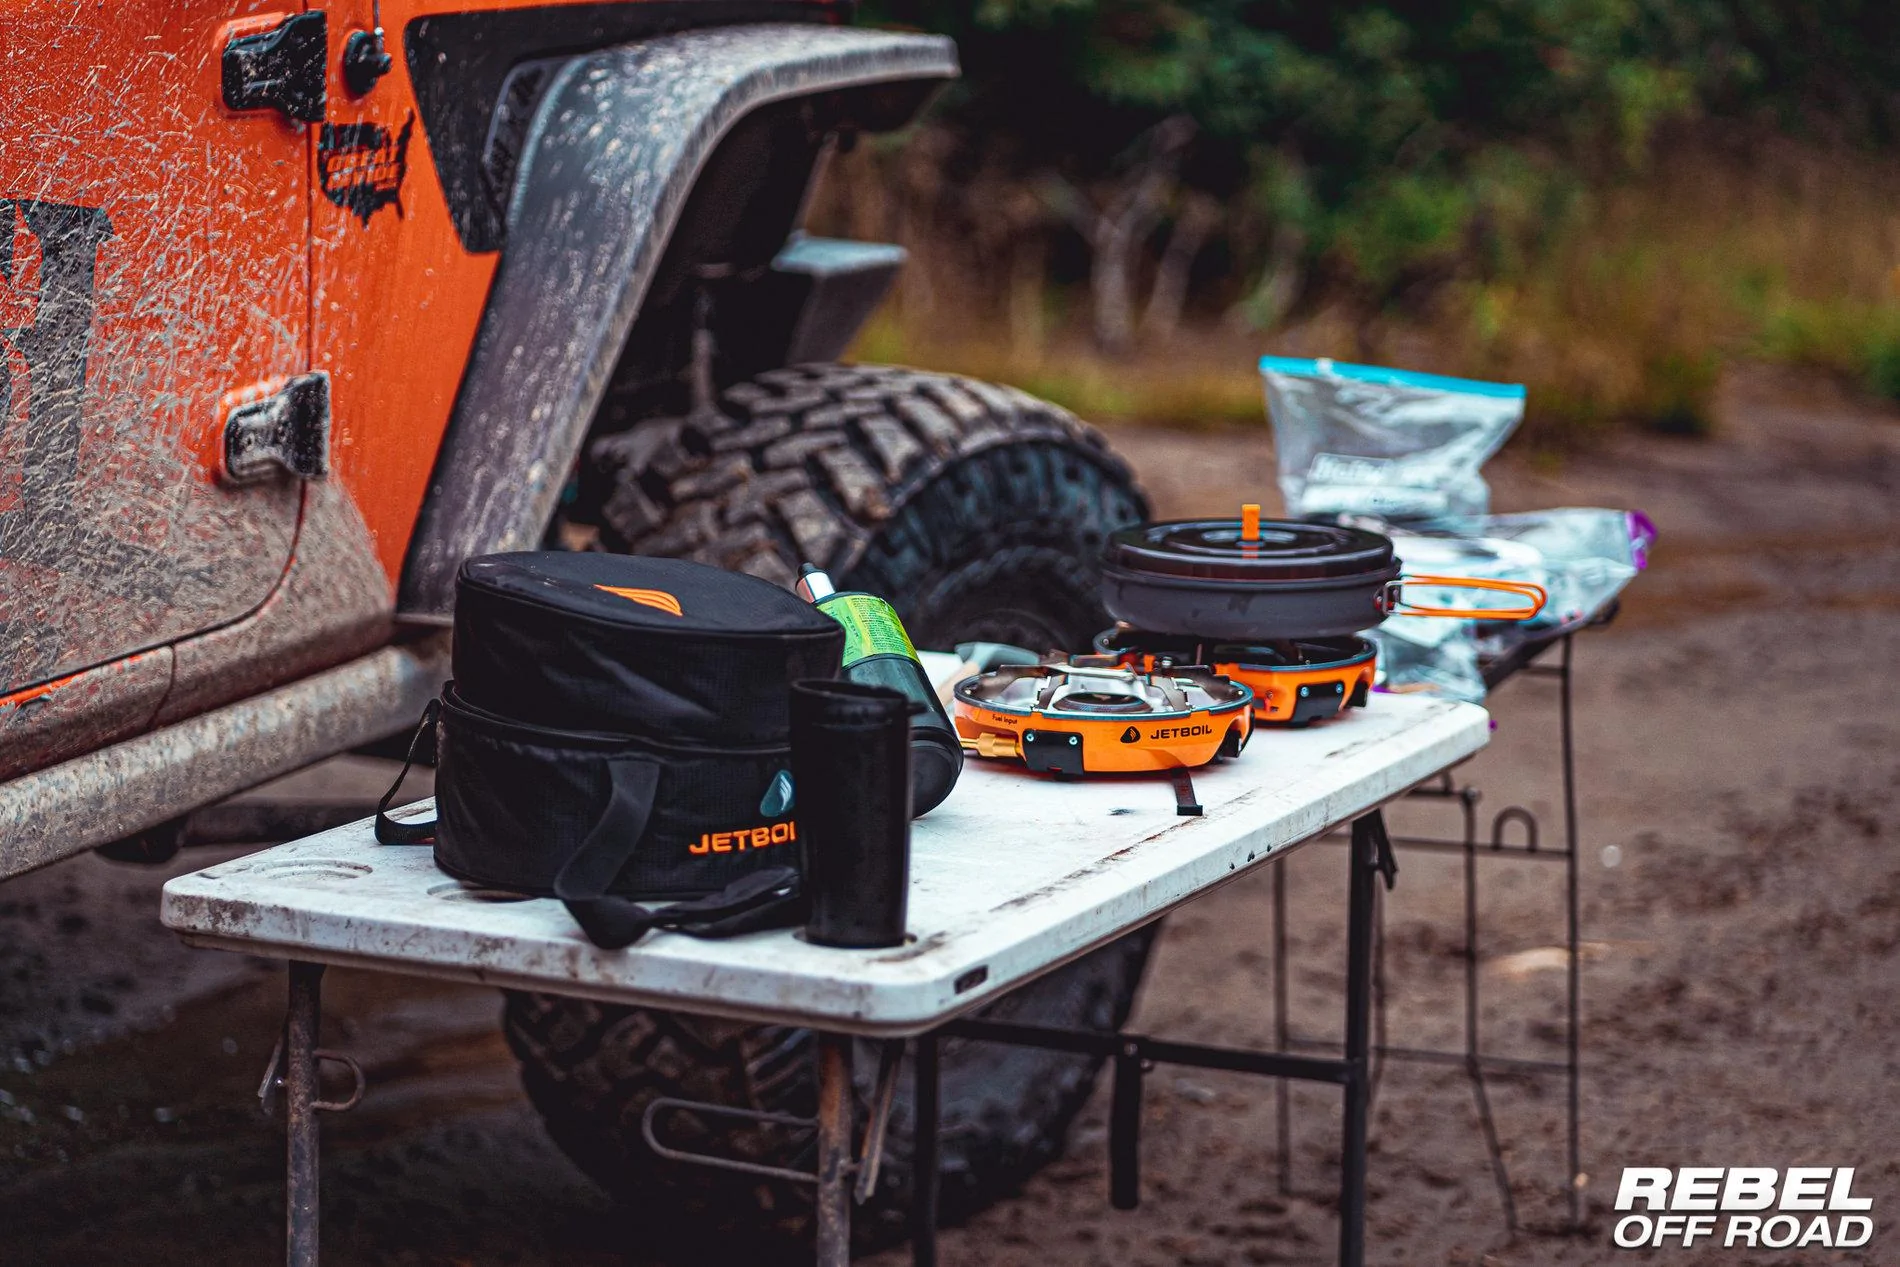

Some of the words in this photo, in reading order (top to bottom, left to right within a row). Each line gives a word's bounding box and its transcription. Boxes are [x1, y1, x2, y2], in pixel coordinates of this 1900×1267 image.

[991, 713, 1003, 722] Fuel
[1003, 716, 1018, 726] Input
[1150, 725, 1213, 740] JETBOIL
[688, 821, 797, 855] JETBOI
